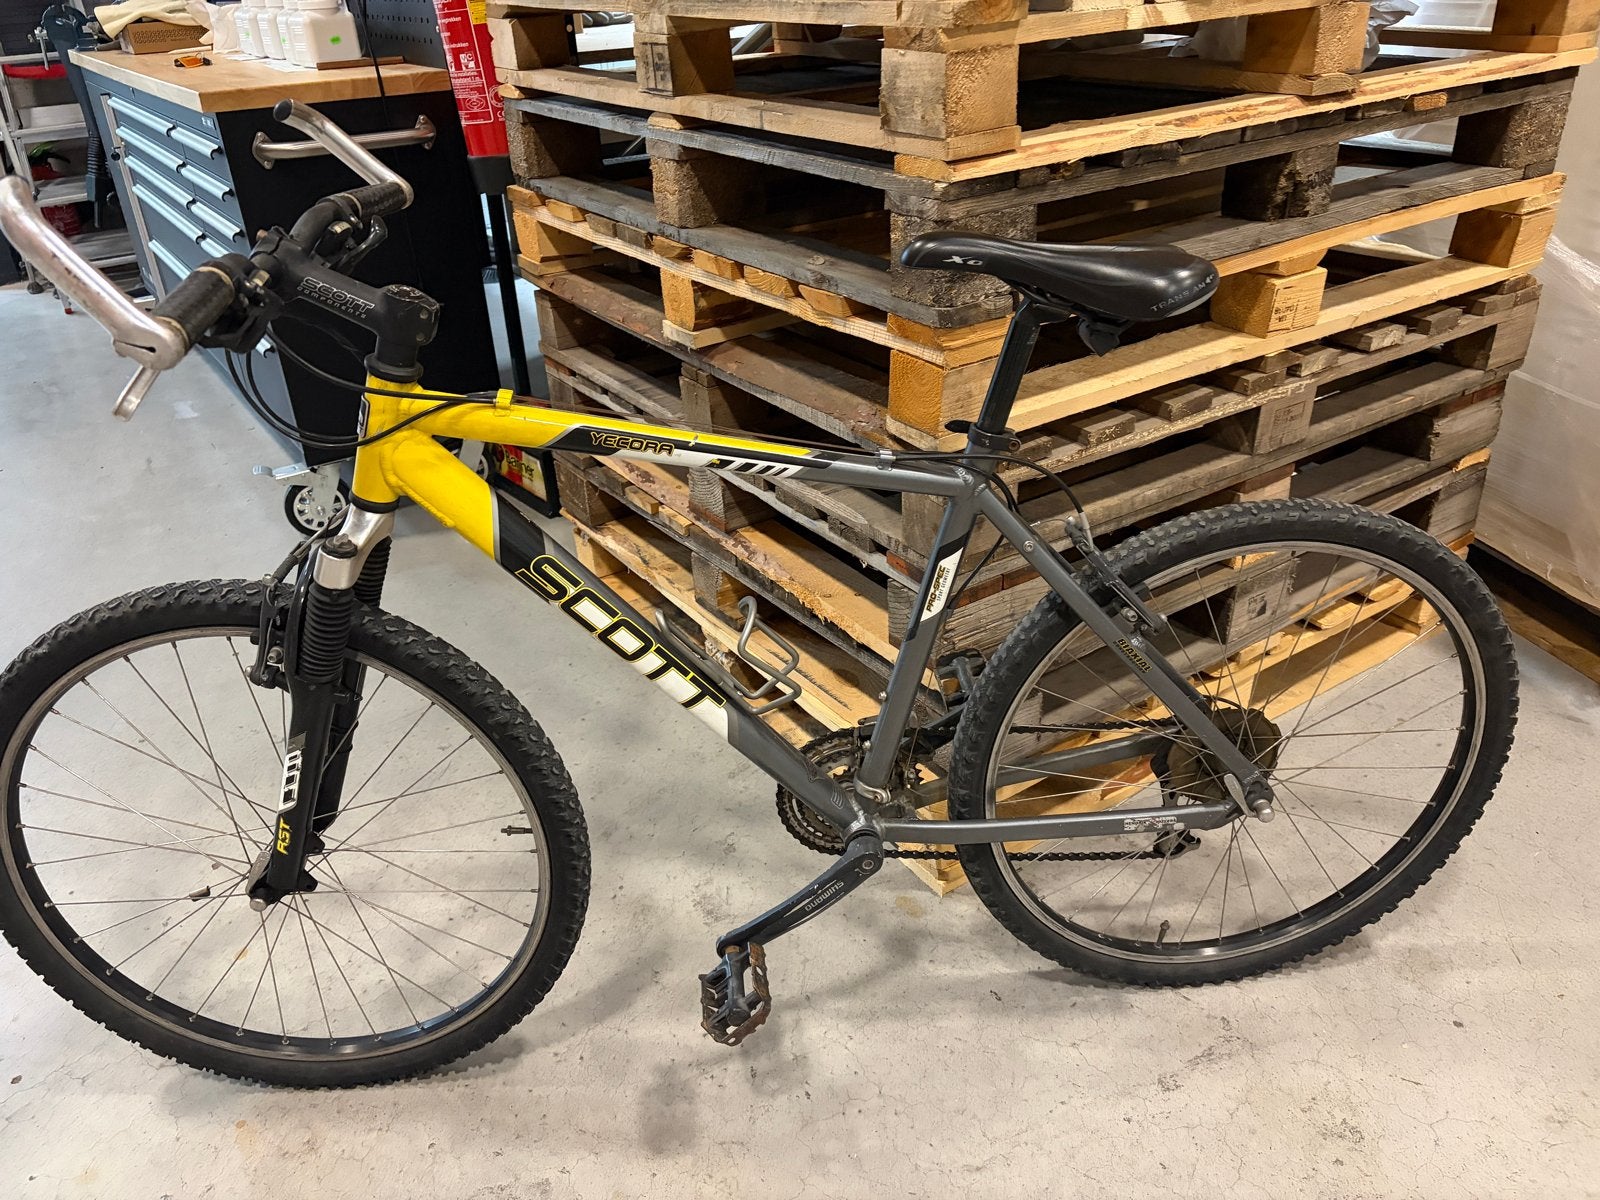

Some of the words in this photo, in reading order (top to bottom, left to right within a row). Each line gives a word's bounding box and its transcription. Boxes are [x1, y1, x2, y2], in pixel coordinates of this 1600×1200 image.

[300, 276, 375, 313] SCOTT
[1150, 289, 1189, 312] TRANS
[591, 432, 675, 456] YECORA
[926, 565, 946, 612] PRO-SPEC
[514, 555, 727, 709] SCOTT
[1117, 638, 1152, 672] BIAXIAL
[276, 816, 292, 855] RST
[804, 881, 844, 911] SHIMANO
